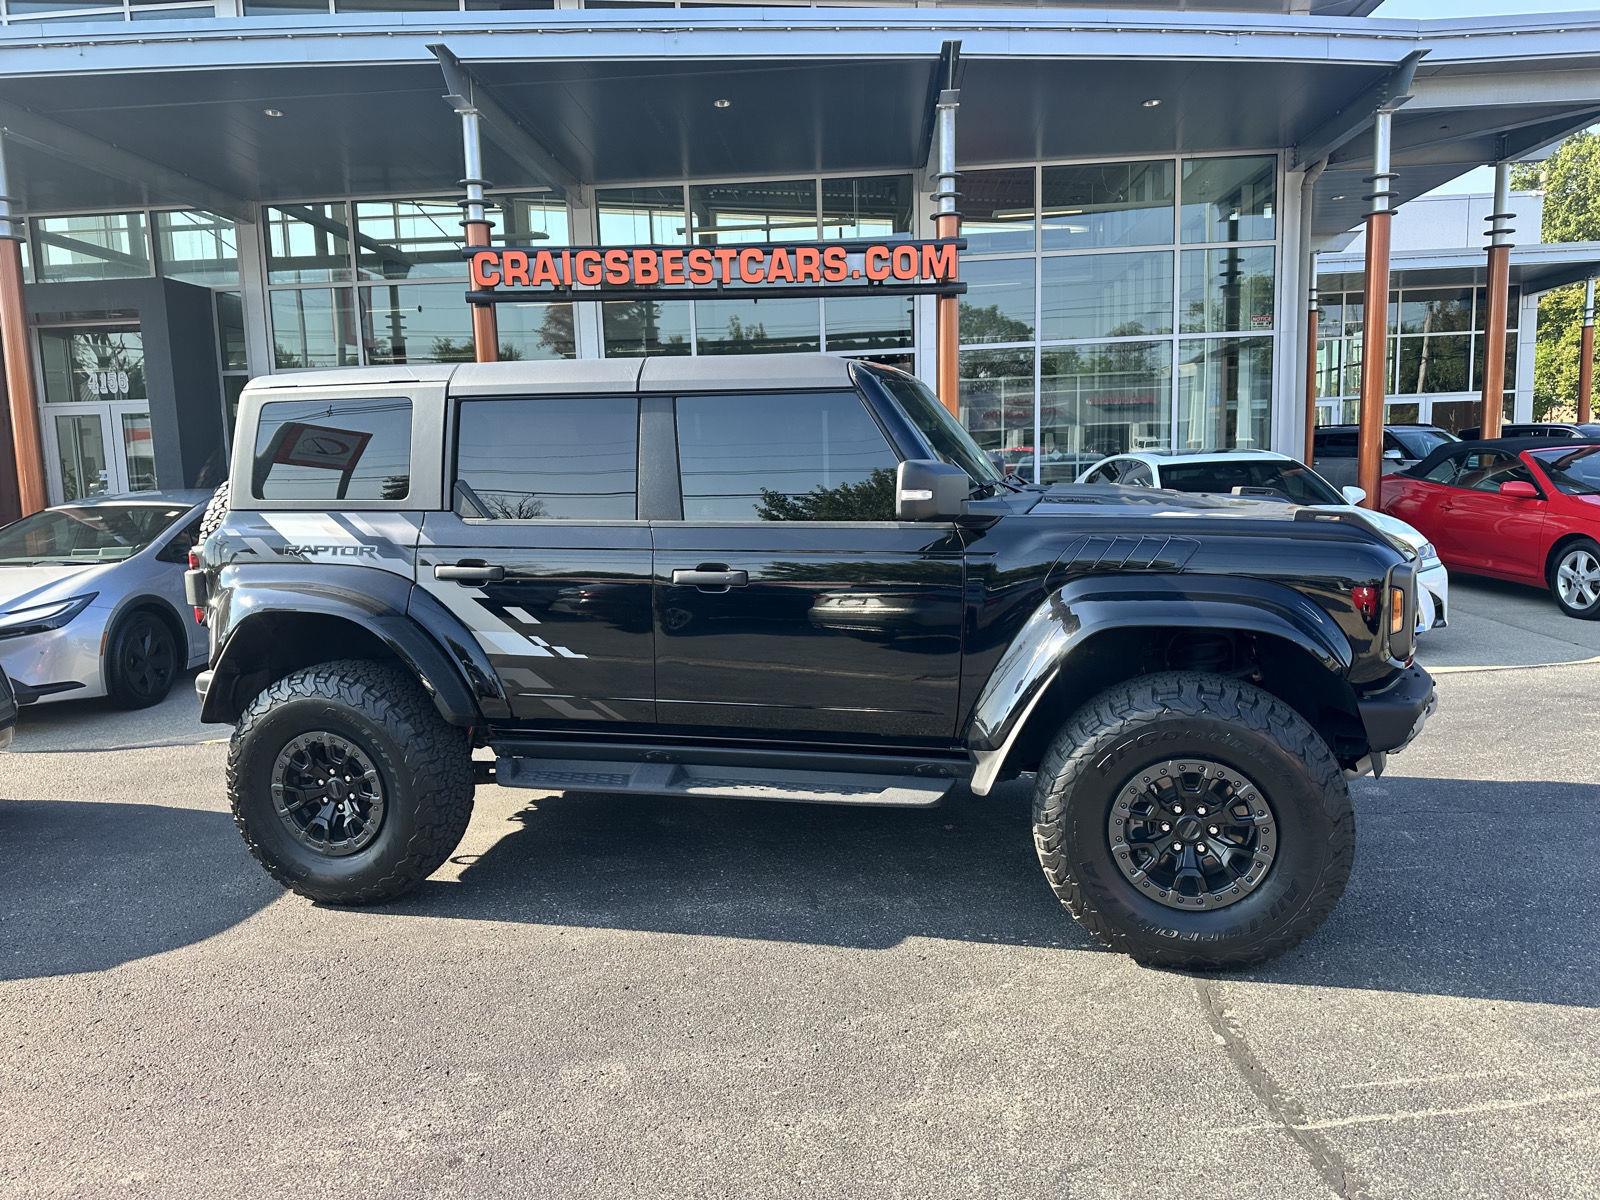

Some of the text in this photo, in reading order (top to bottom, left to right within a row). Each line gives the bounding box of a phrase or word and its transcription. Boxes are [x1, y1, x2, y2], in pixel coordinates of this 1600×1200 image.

[472, 243, 958, 288] CRAIGSBESTCARS.COM
[87, 371, 129, 395] 4156
[284, 544, 378, 561] RAPTOR
